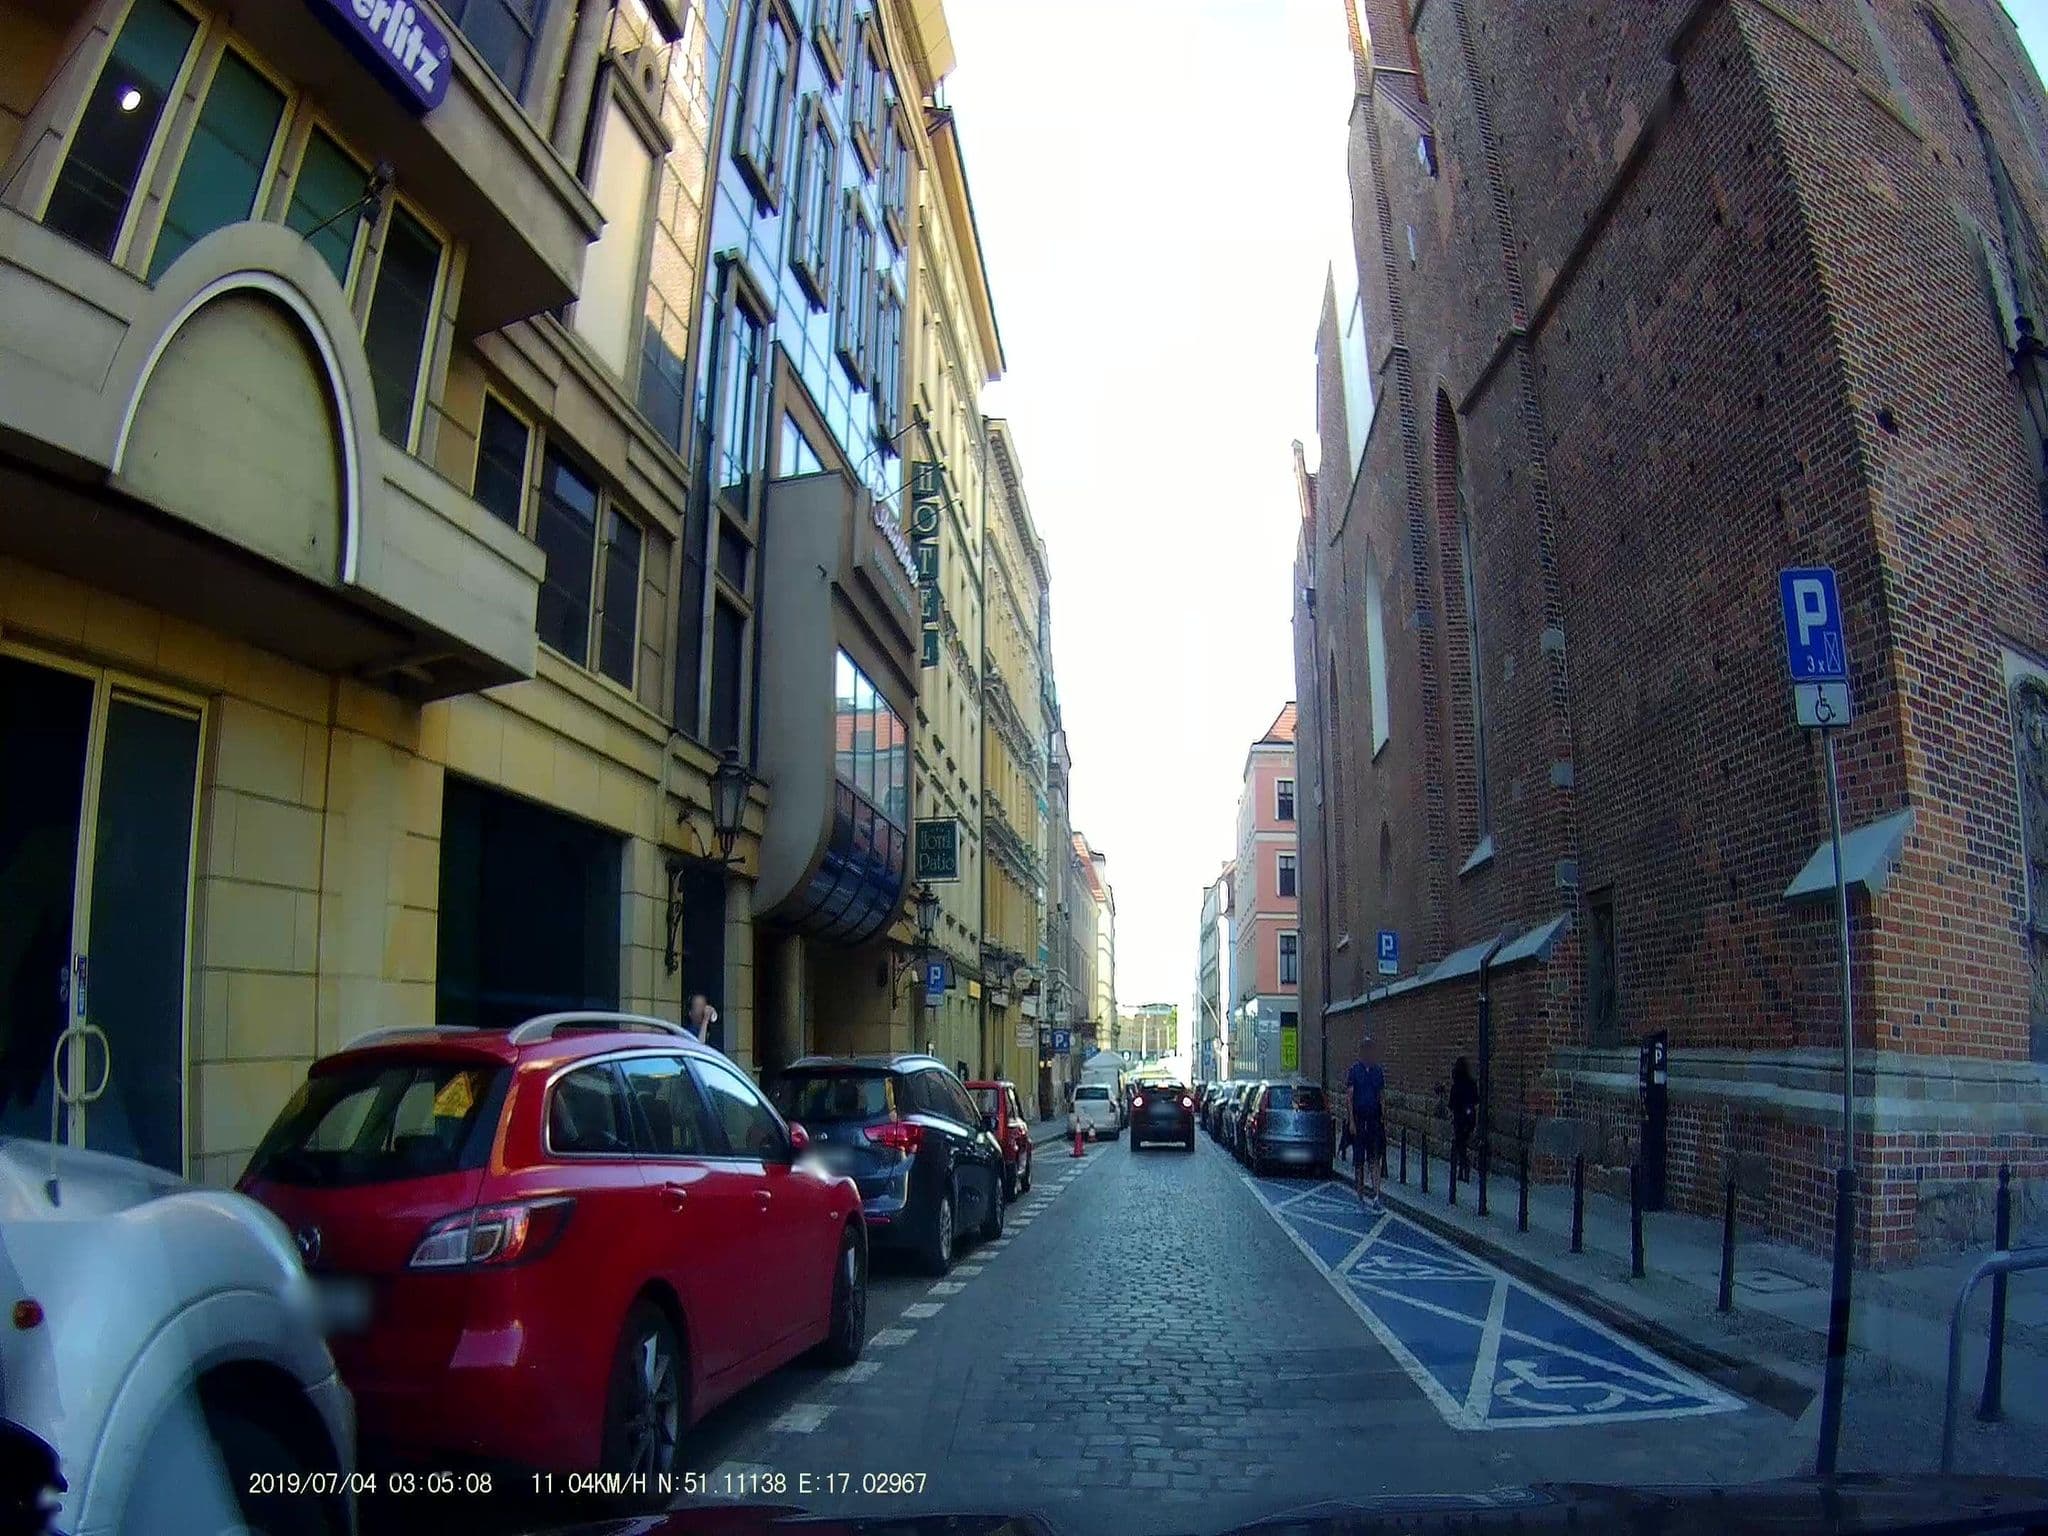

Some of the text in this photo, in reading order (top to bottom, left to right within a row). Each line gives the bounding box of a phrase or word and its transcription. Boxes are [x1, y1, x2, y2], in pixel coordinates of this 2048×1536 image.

[914, 465, 937, 660] HOTEL
[1792, 578, 1828, 646] P
[1381, 934, 1394, 957] P
[930, 966, 942, 985] P
